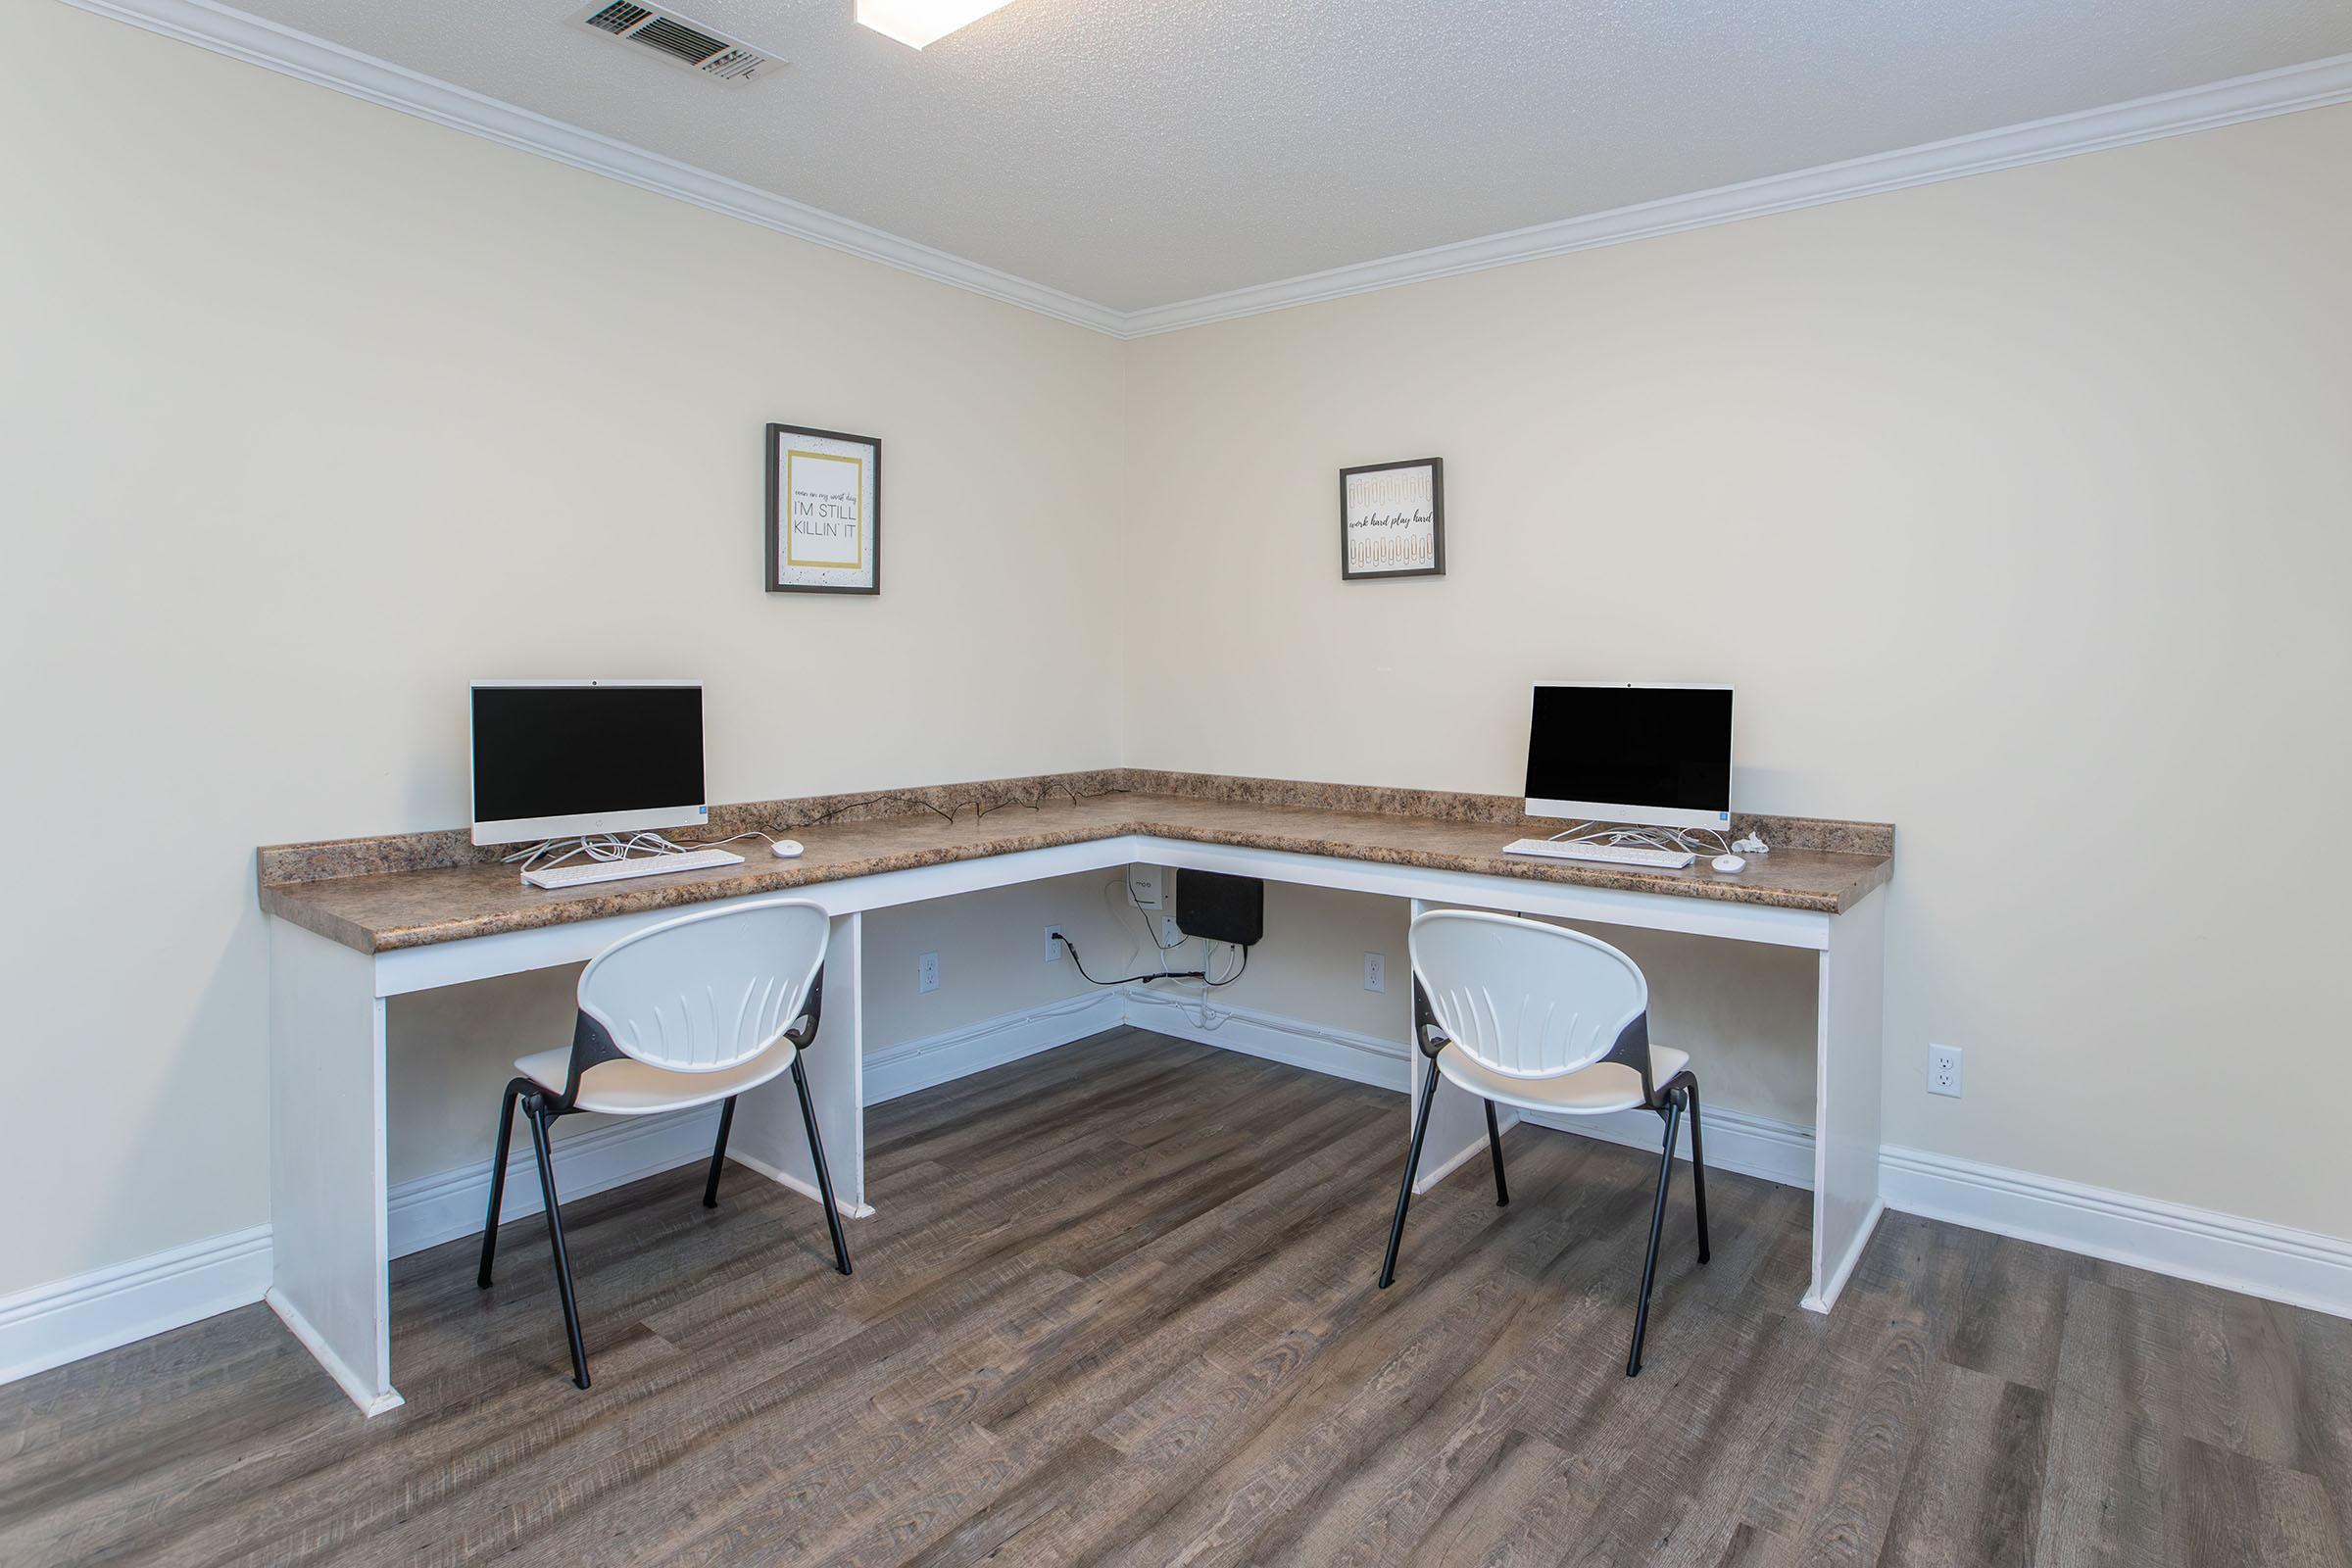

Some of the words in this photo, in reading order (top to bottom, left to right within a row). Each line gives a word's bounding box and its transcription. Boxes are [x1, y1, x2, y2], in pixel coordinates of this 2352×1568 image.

[795, 501, 813, 516] I'M
[818, 504, 857, 520] STILL
[1349, 515, 1368, 528] work
[1371, 513, 1389, 526] hard
[1390, 513, 1410, 528] play
[1413, 509, 1432, 522] hard
[795, 520, 840, 537] KILLIN'
[844, 524, 857, 538] IT
